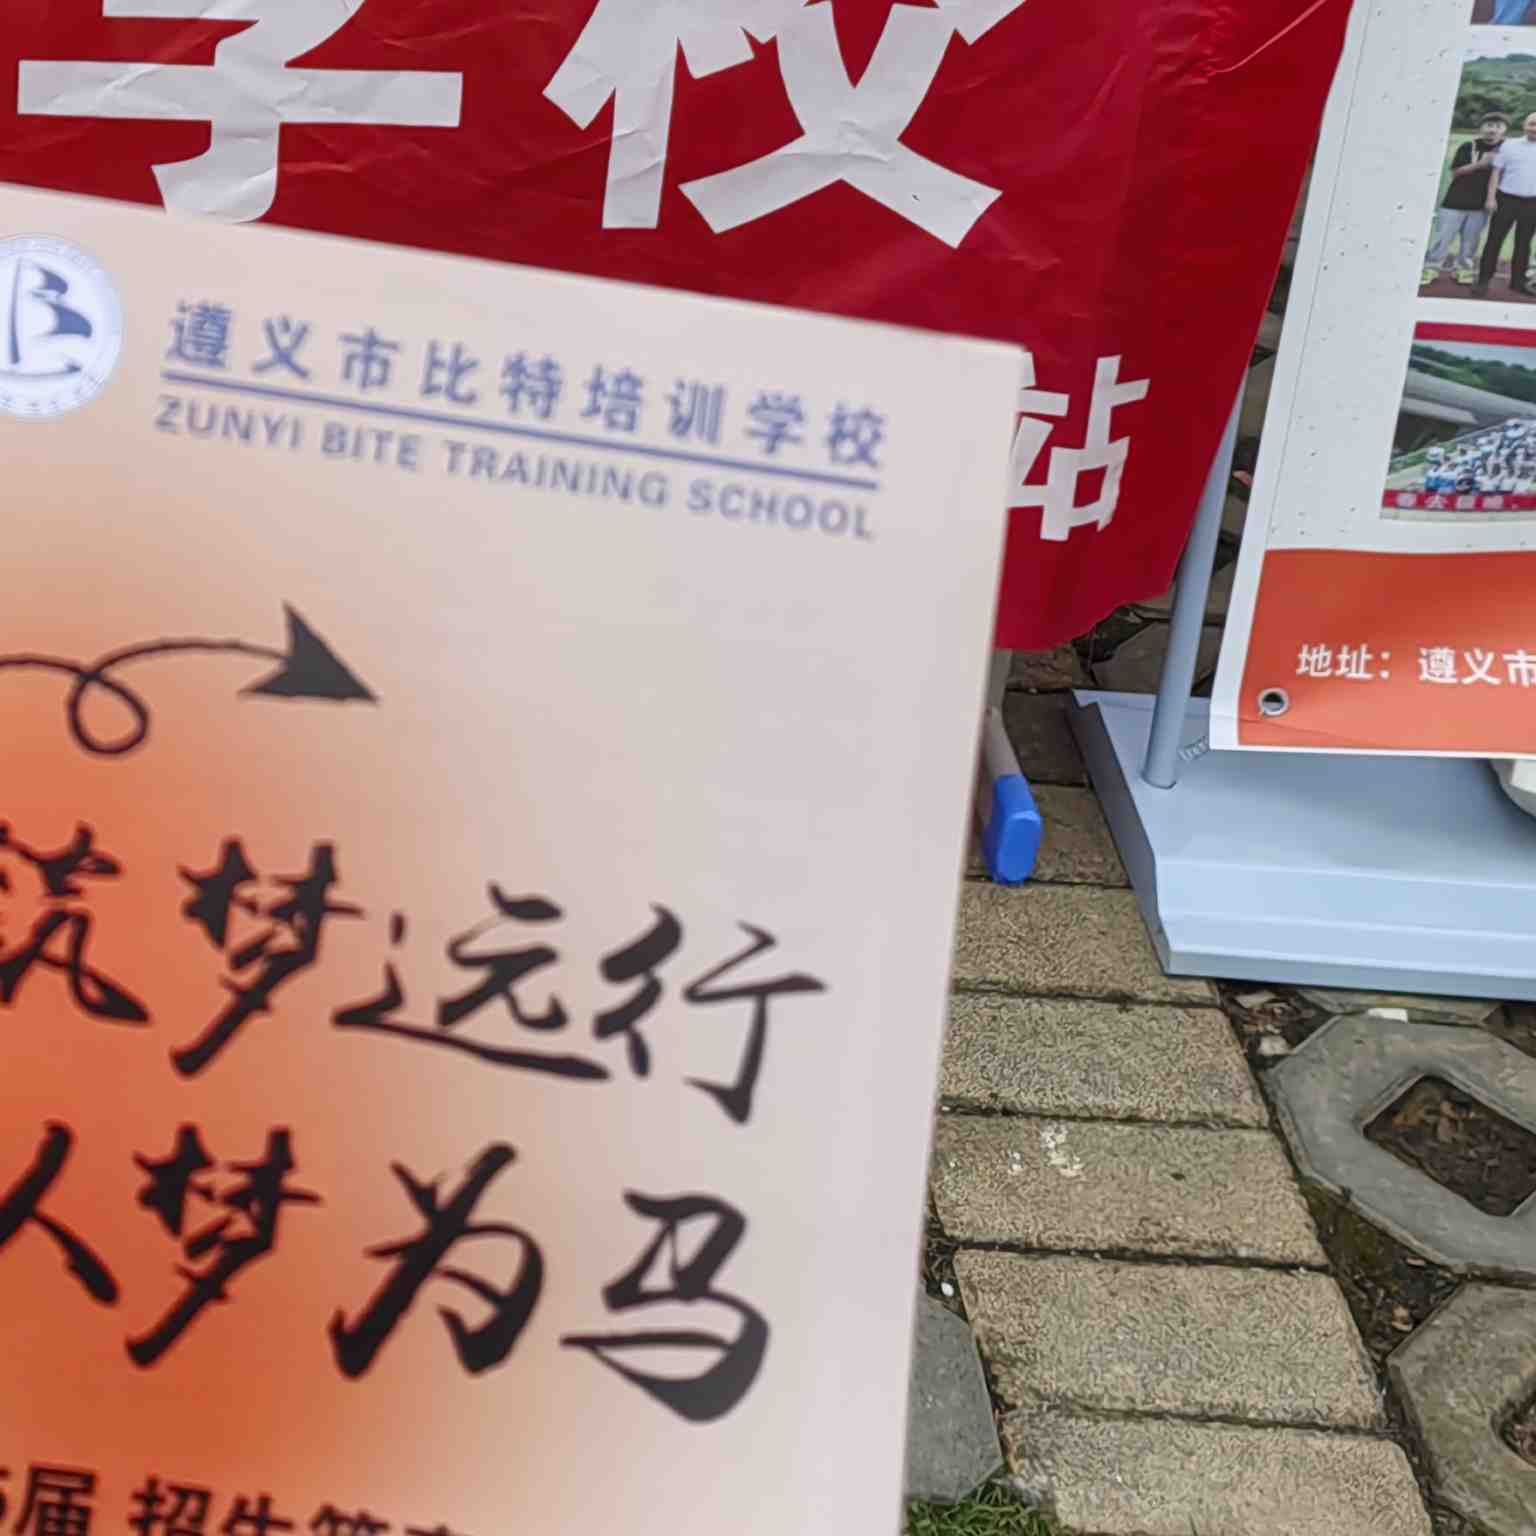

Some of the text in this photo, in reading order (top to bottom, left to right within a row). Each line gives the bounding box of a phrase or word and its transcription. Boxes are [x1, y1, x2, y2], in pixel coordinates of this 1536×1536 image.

[164, 301, 888, 470] 遵义市比特培训学校
[153, 394, 876, 540] ZUNYI BITE TRAINING SCHOOL
